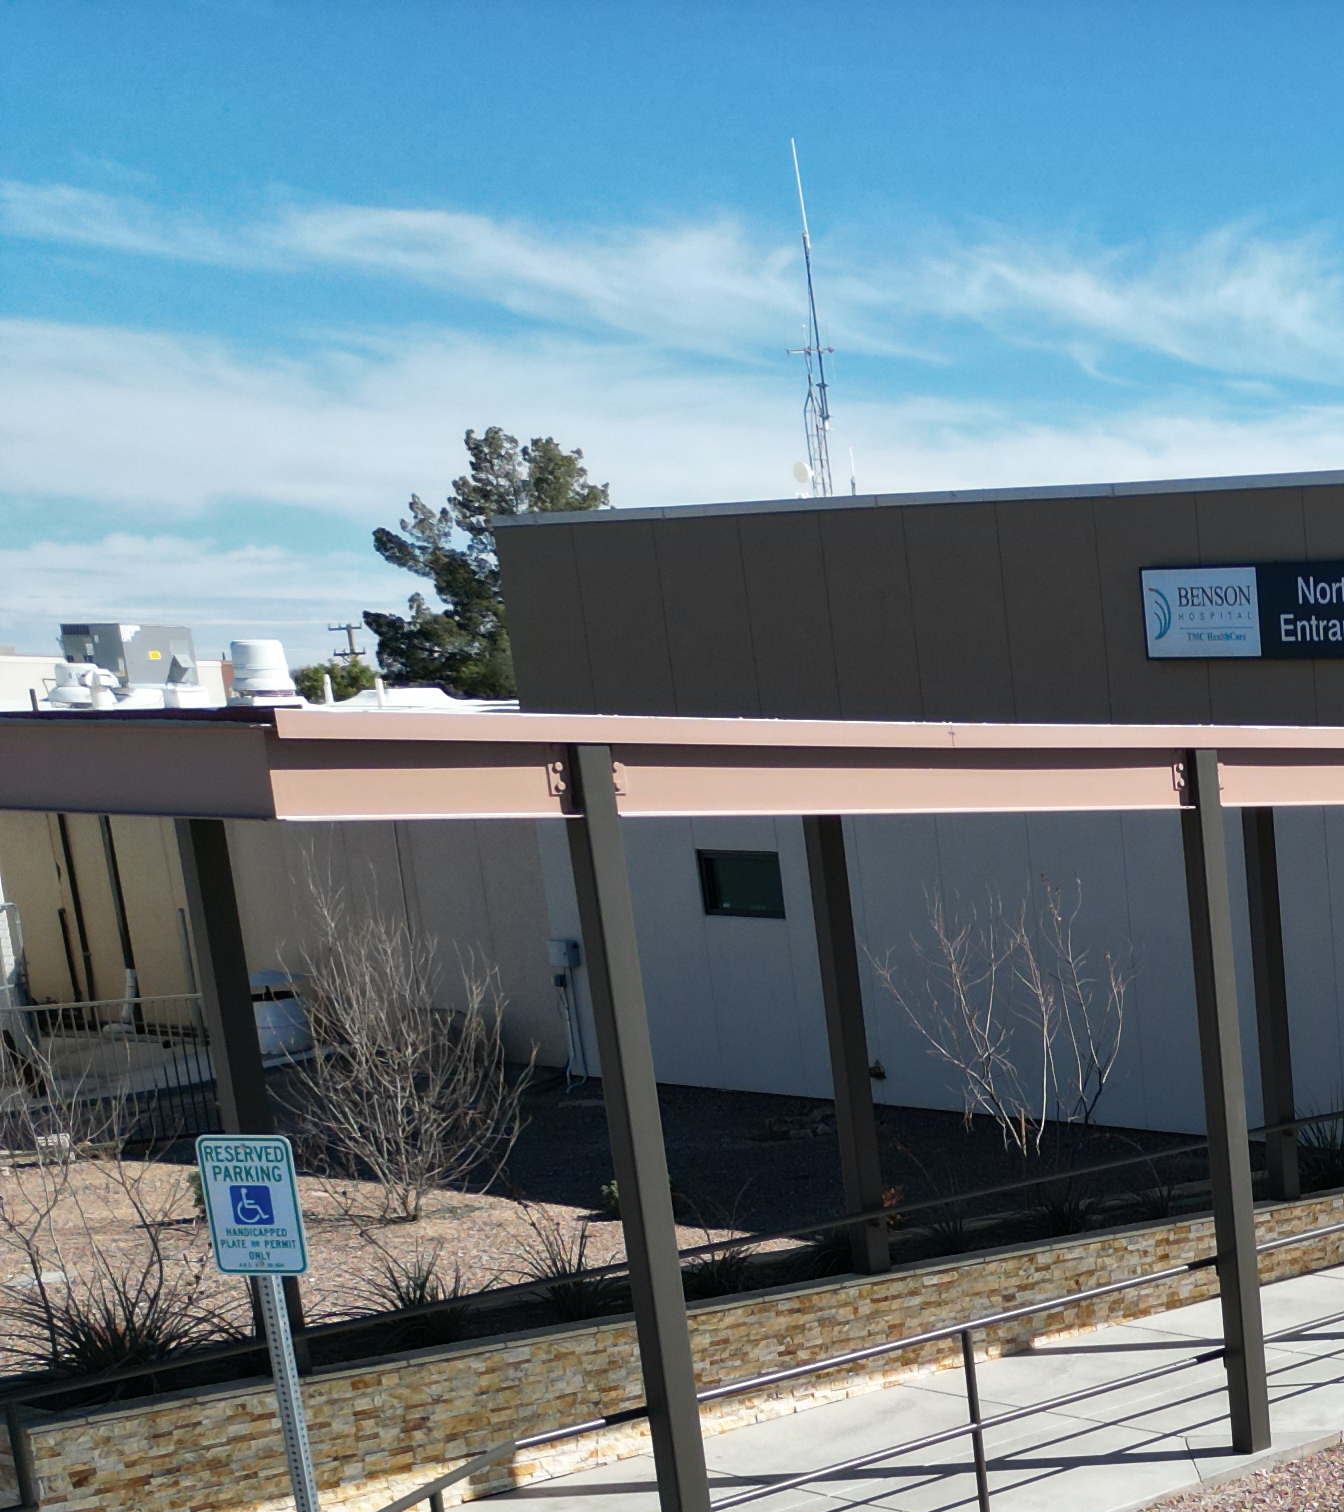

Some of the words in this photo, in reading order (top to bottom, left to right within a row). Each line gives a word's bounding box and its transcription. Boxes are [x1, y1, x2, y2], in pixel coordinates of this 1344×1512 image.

[1177, 585, 1251, 608] BENSON
[1178, 611, 1252, 621] HOSPITAL
[1187, 632, 1206, 641] TMC
[1207, 631, 1247, 641] HealthCare
[203, 1145, 285, 1163] RESERVED
[212, 1165, 283, 1183] PARKING
[226, 1227, 288, 1238] HANDICAPPED
[220, 1239, 246, 1249] PLATE
[264, 1239, 297, 1249] PERMIT
[248, 1251, 271, 1261] ONLY
